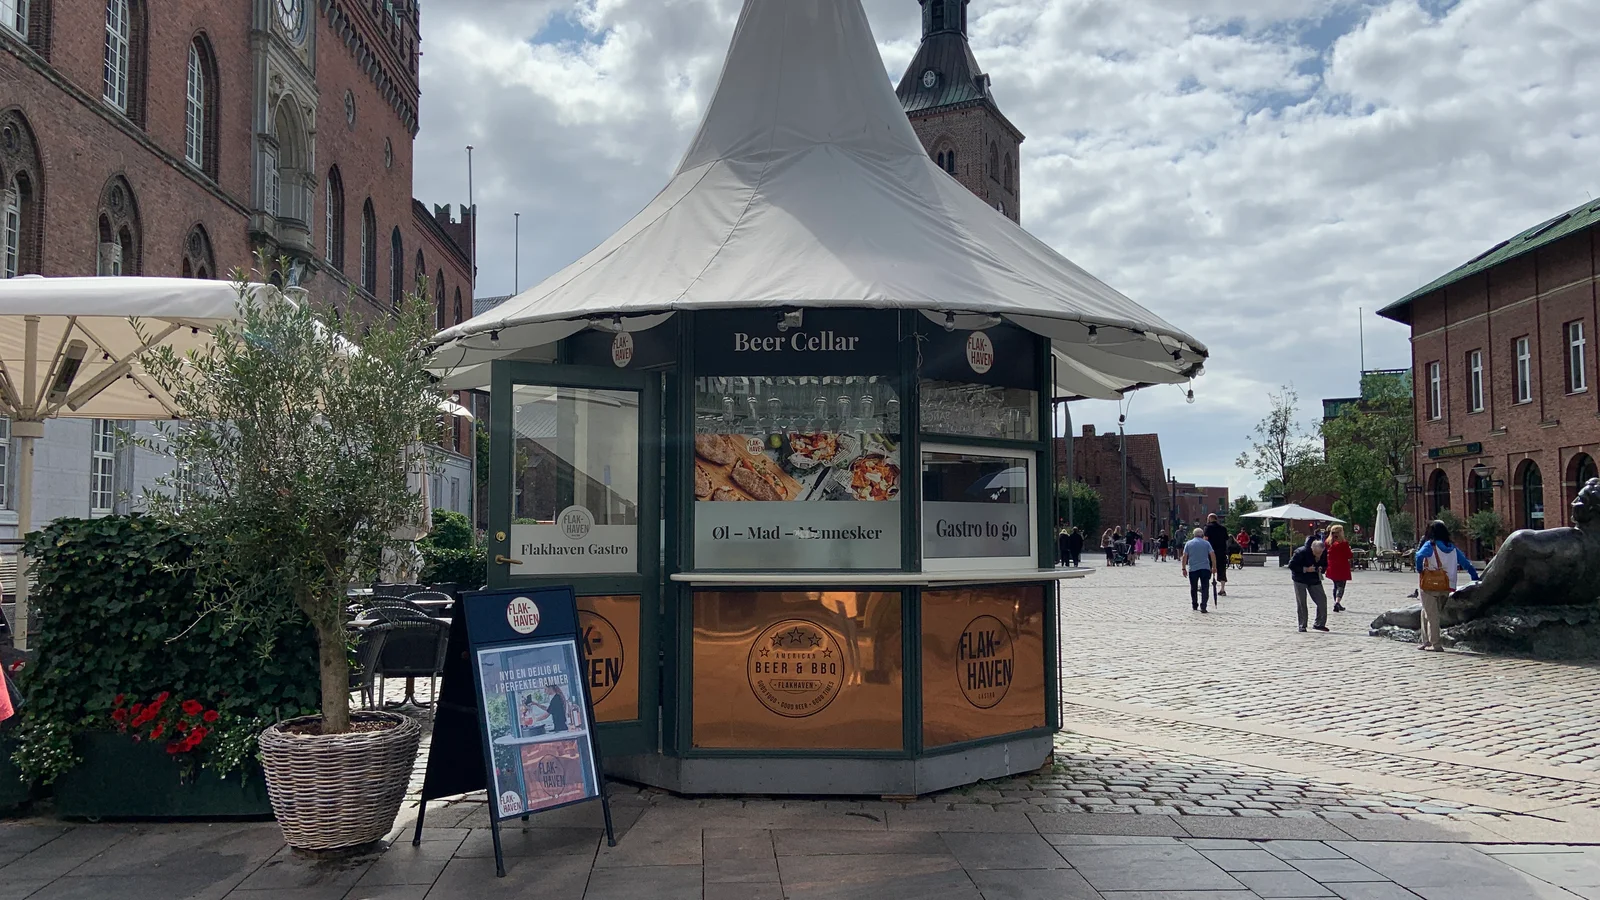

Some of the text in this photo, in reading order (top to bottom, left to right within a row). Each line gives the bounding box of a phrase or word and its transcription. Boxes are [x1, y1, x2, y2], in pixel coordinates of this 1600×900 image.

[613, 336, 629, 349] FLAK-
[734, 331, 859, 352] Beer Cellar
[967, 337, 988, 351] FLAK-
[615, 347, 633, 360] HAVEN
[971, 351, 993, 366] HAVEN
[563, 514, 584, 525] FLAK-
[566, 524, 589, 534] HAVEN
[712, 525, 730, 540] Øl
[747, 525, 780, 540] Mad
[936, 519, 1017, 541] Gastro to go
[521, 543, 629, 556] Flakhaven Gastro
[508, 602, 532, 615] FLAK-
[513, 613, 540, 627] HAVEN
[960, 629, 1001, 660] FLAK-
[776, 652, 817, 660] AMERICAN
[499, 663, 563, 681] NYD EN DEJLIG ØL
[755, 661, 837, 675] BEER & BBQ
[967, 658, 1013, 690] HAVEN
[495, 674, 569, 693] I PERFEKTE RAMMER
[777, 681, 814, 689] FLAKHAVEN
[757, 680, 768, 694] GOOD
[765, 691, 778, 704] FOOD
[780, 701, 794, 710] GOOD
[811, 694, 825, 706] GOOD
[823, 680, 835, 696] TIMES
[539, 761, 558, 775] FLAK-
[543, 773, 566, 788] HAVEN
[500, 796, 516, 805] FLAK-
[503, 801, 522, 813] HAVEN
